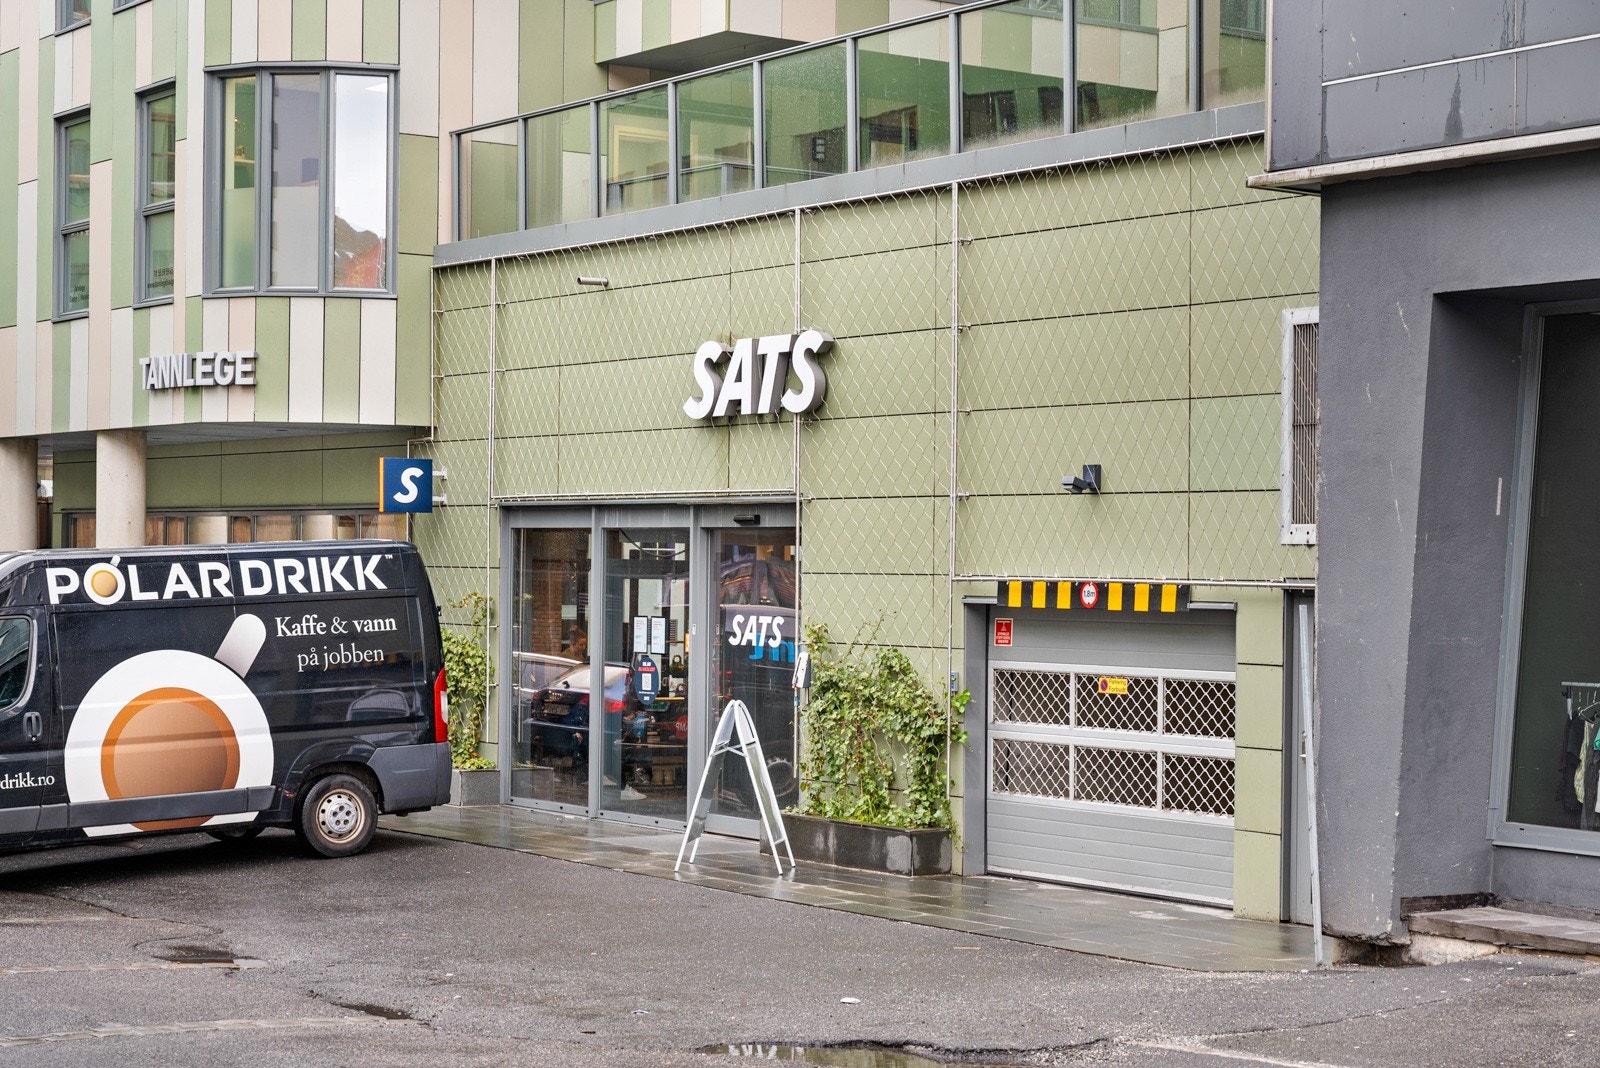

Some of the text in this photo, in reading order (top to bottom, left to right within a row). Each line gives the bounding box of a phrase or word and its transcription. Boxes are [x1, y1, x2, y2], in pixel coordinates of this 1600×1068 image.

[139, 351, 257, 390] TANNLEGE
[683, 330, 834, 420] SATS
[393, 467, 424, 504] S
[275, 614, 398, 637] Kaffe & vann
[728, 614, 785, 648] SATS
[297, 642, 385, 673] på jobben
